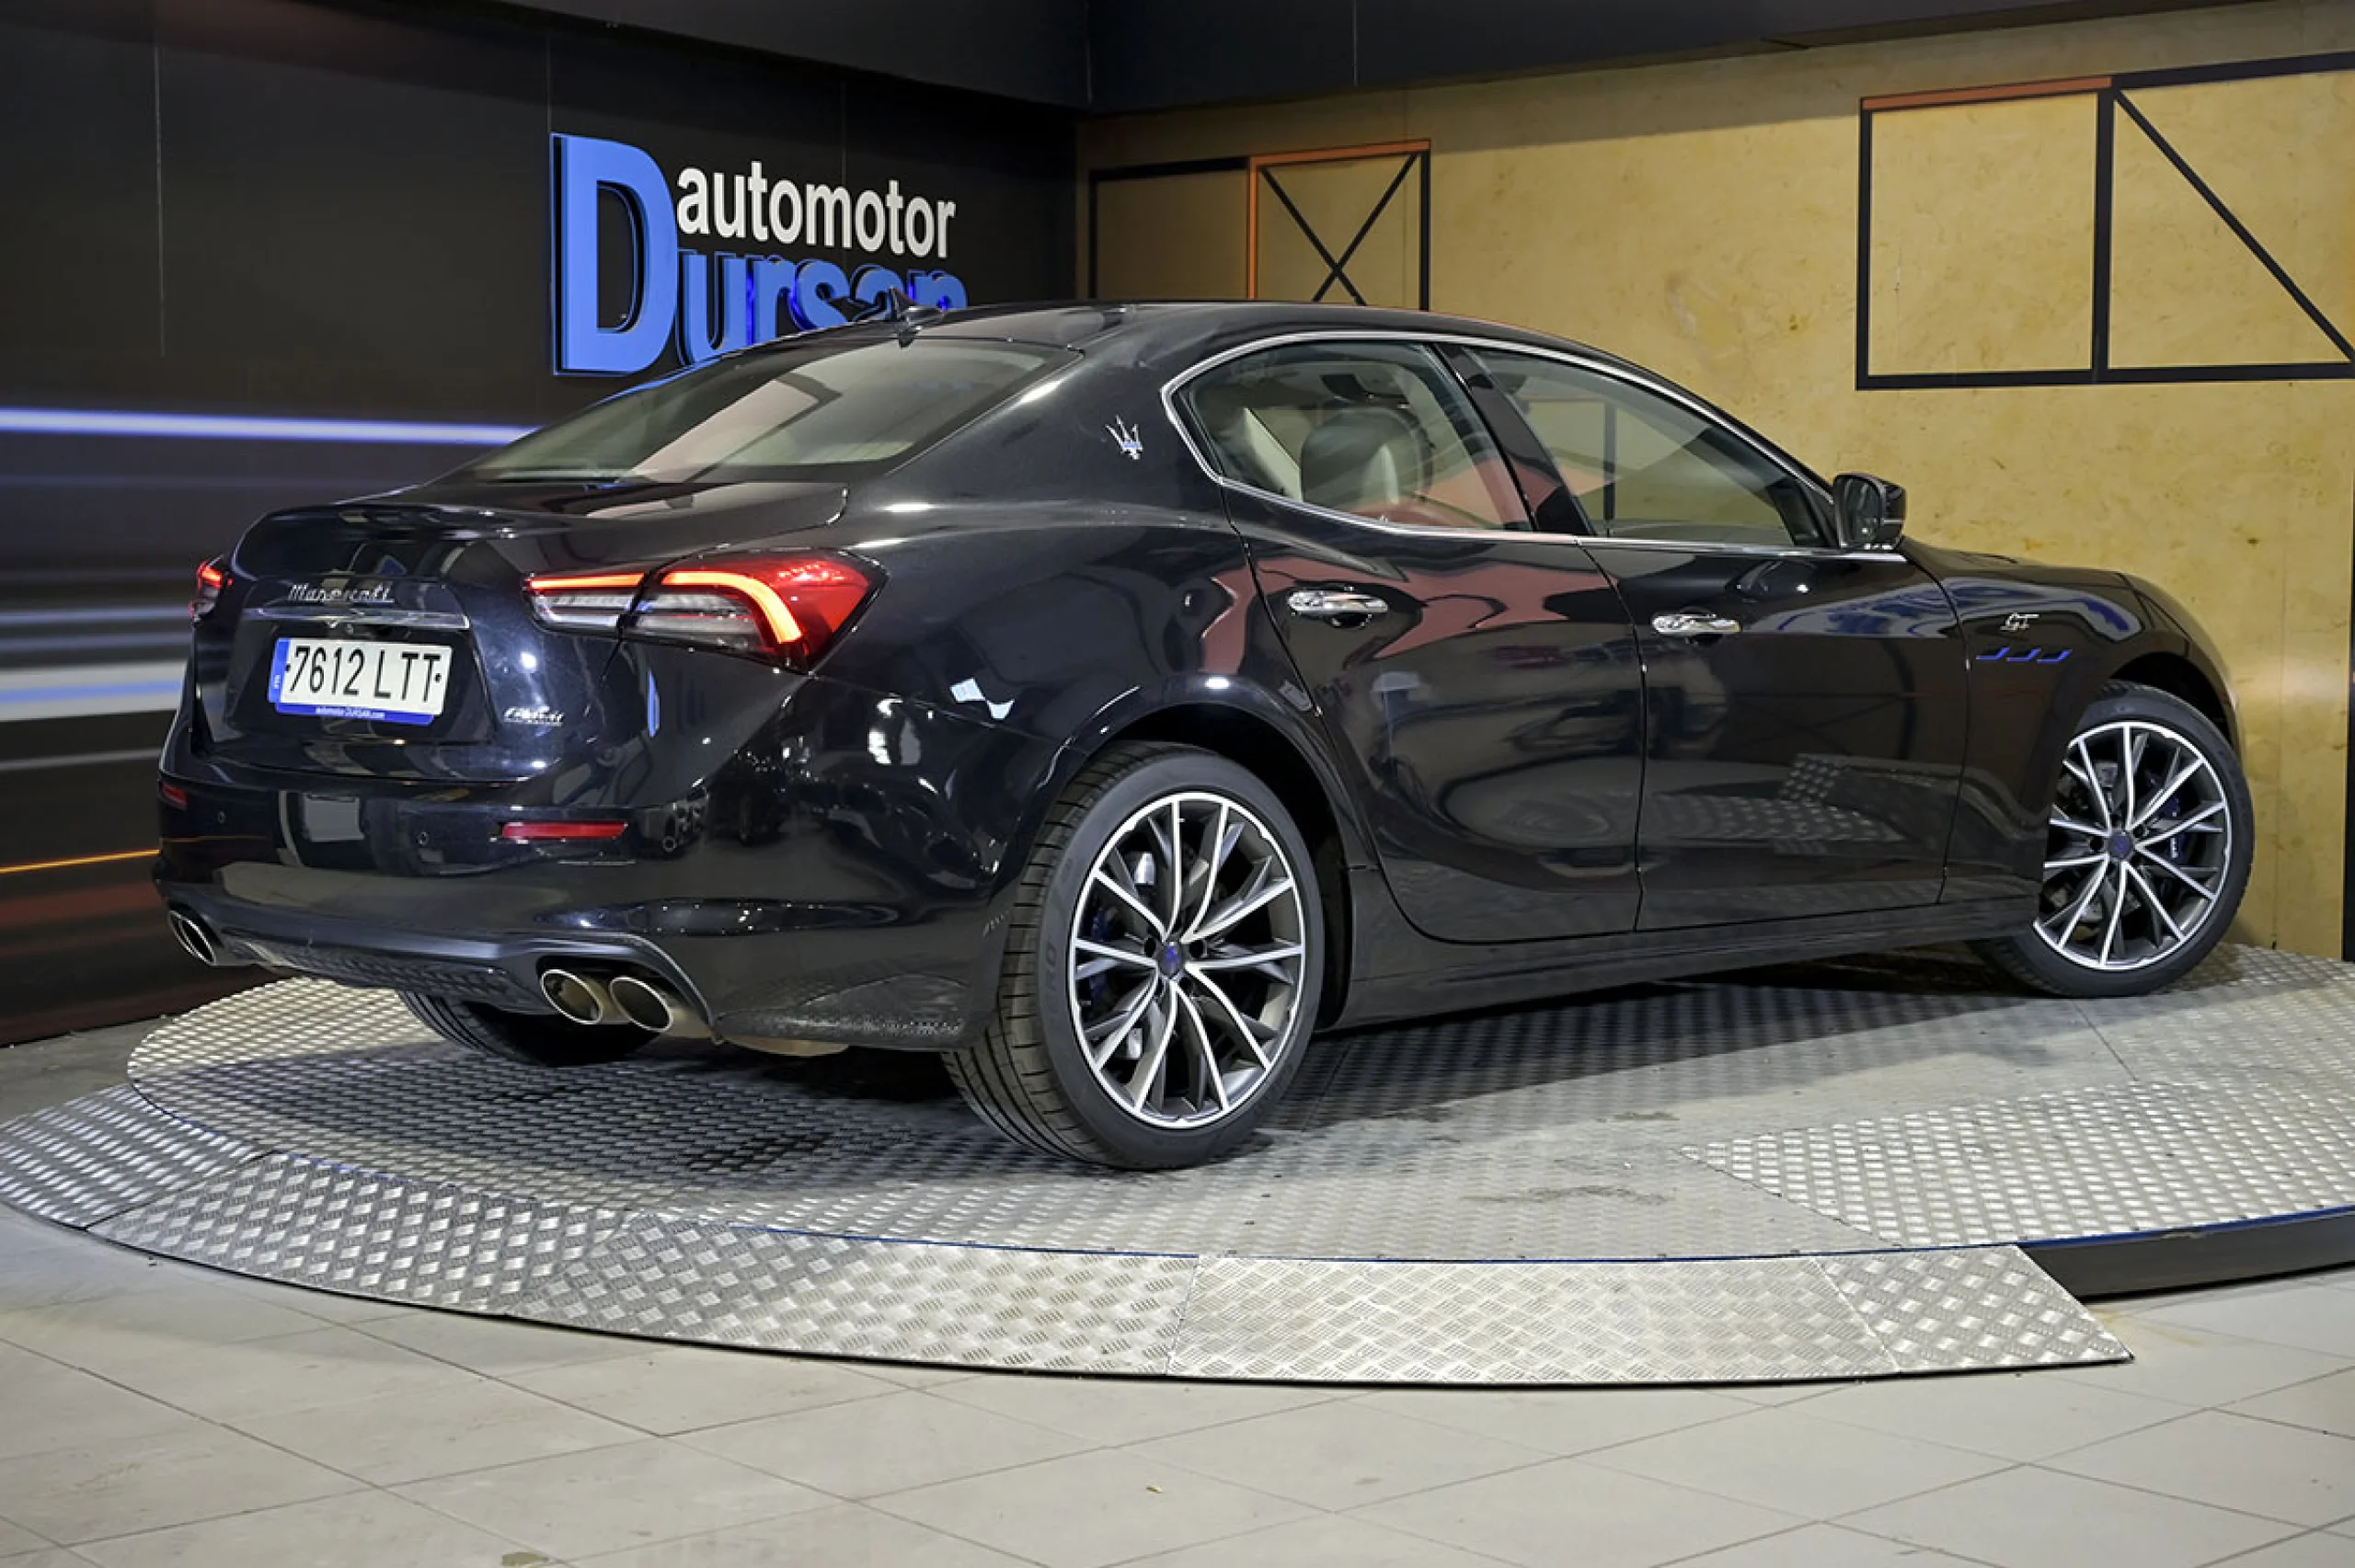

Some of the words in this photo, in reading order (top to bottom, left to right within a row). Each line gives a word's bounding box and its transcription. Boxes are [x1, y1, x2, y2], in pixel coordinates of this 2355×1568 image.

[676, 160, 957, 258] automotor
[289, 645, 365, 696] 7612
[373, 649, 442, 703] LTT
